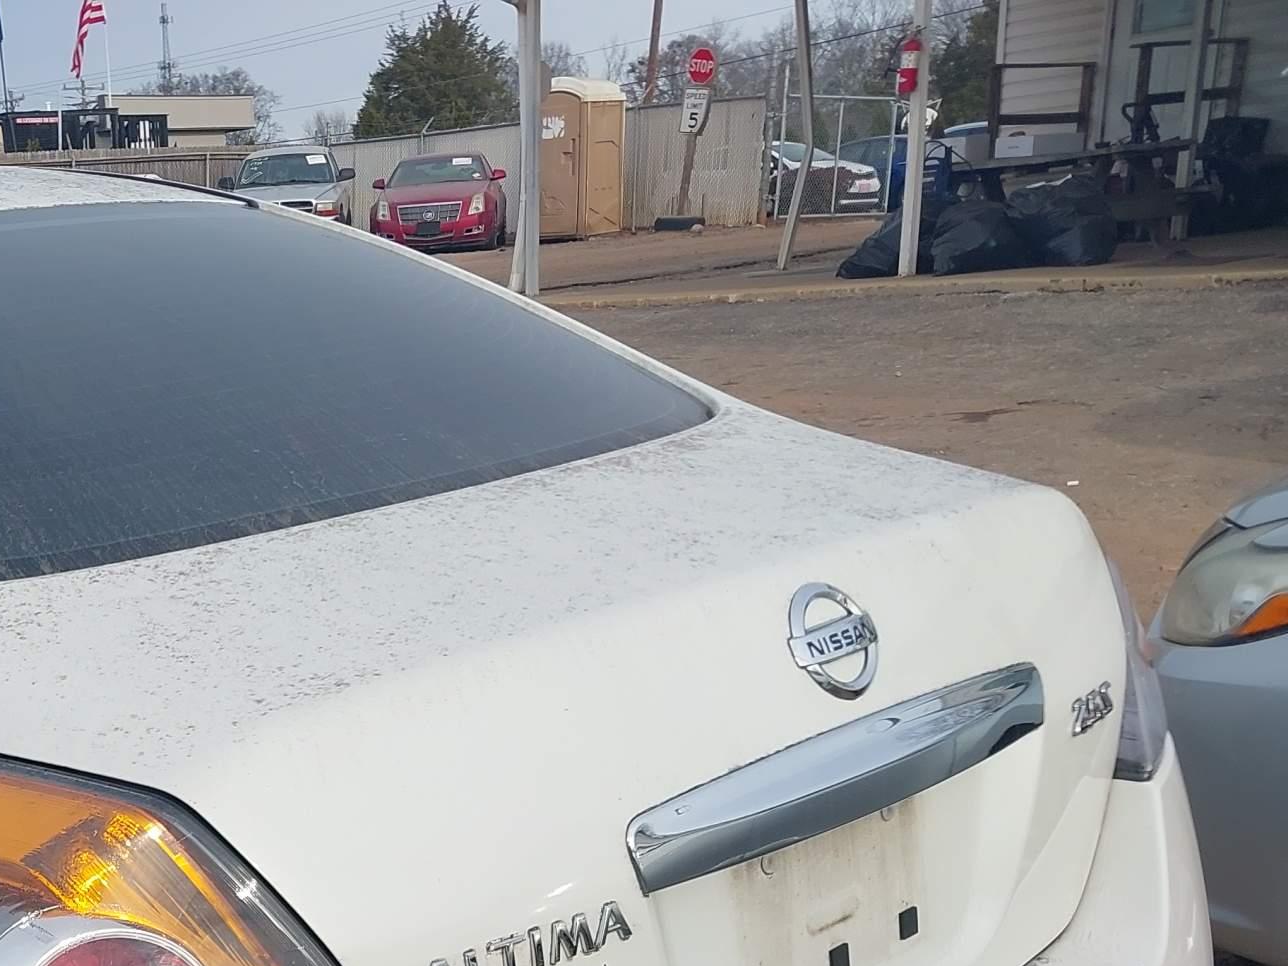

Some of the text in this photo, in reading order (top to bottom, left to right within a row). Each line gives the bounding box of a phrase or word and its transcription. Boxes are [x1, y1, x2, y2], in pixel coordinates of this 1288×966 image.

[690, 59, 713, 73] STOP
[688, 112, 698, 128] 5
[806, 620, 875, 658] NISSAN
